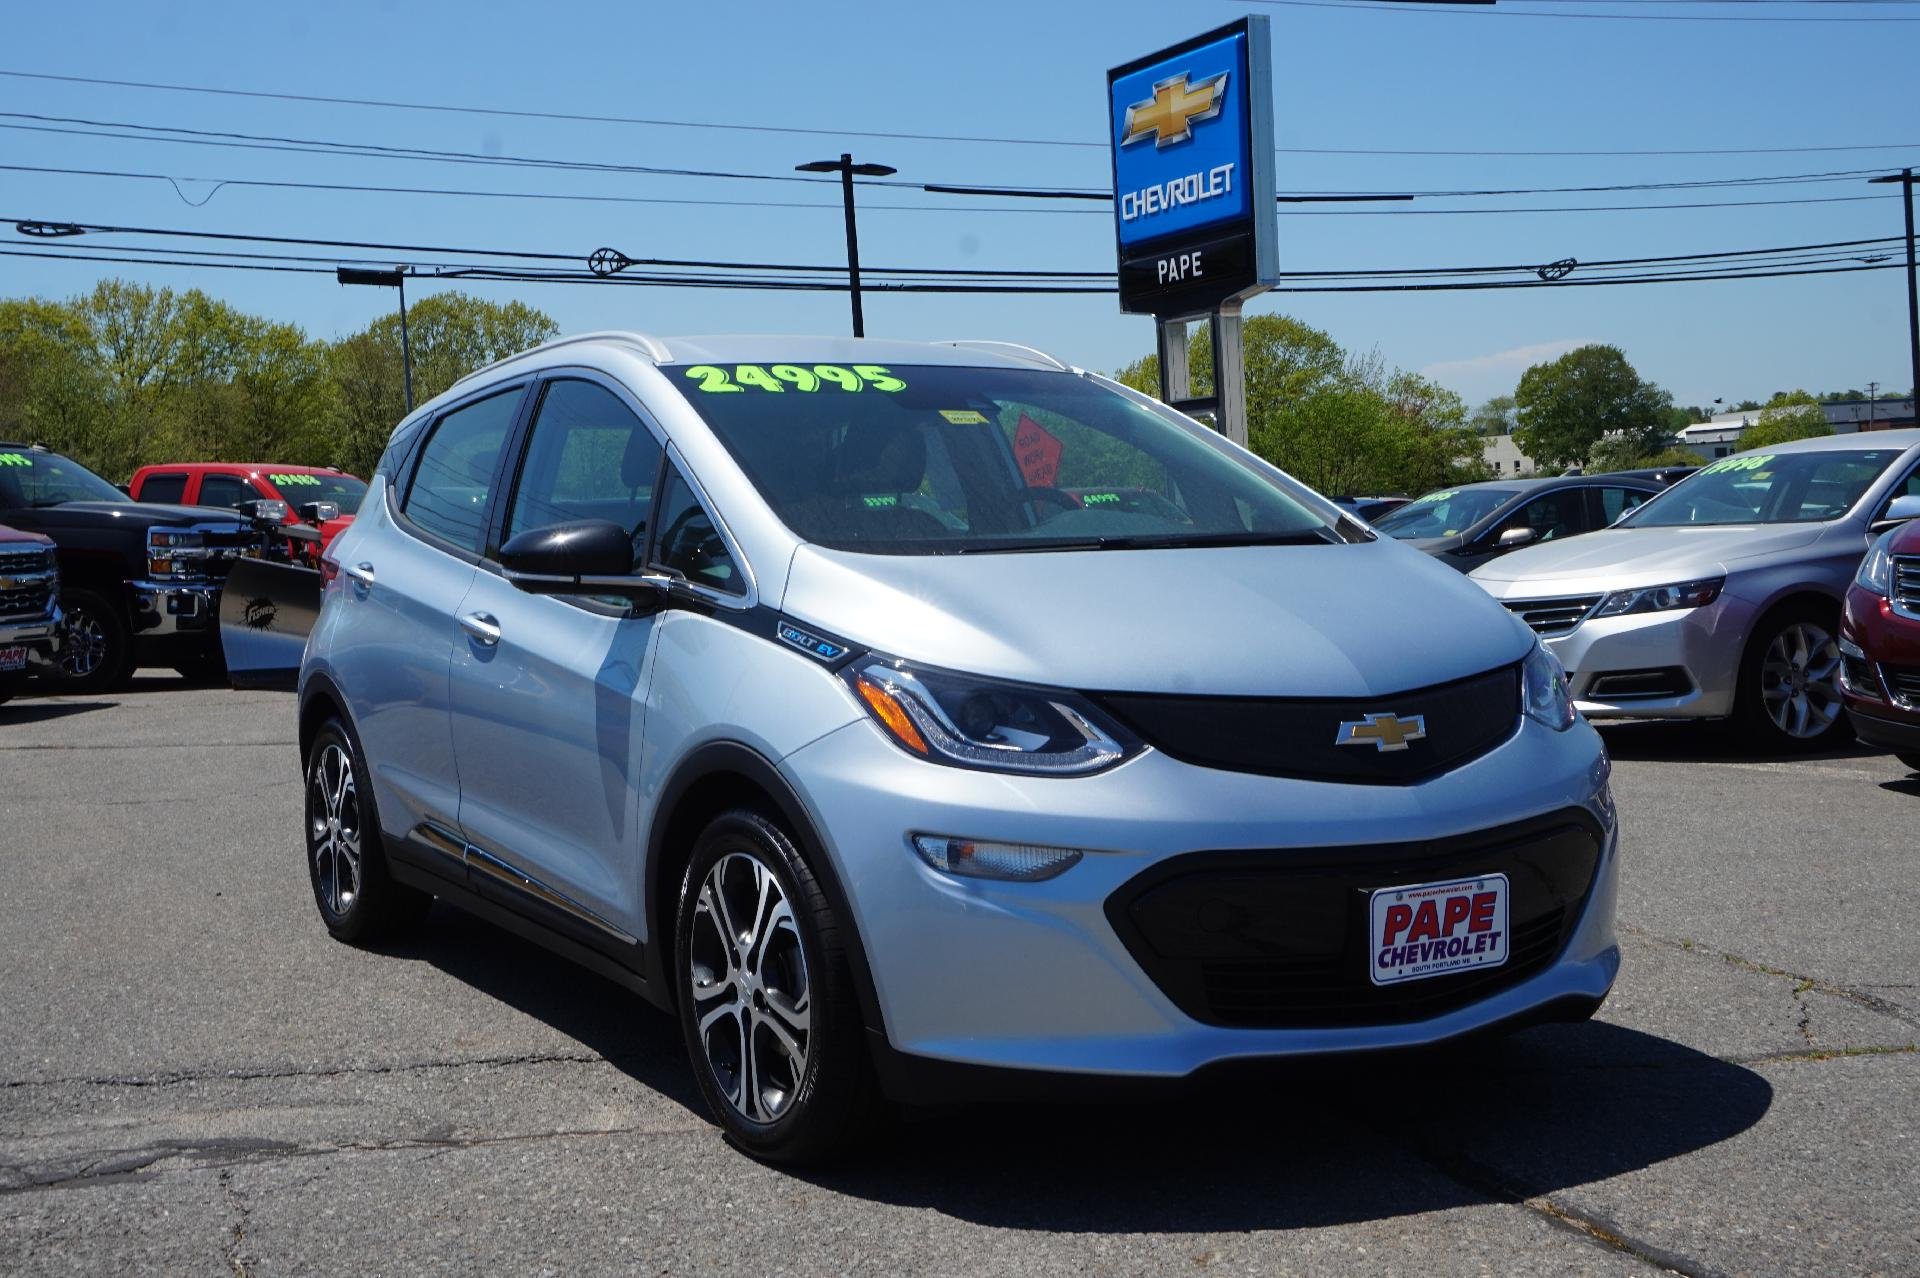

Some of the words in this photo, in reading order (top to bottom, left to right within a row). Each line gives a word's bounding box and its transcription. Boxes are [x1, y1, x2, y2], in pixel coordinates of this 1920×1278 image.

[1122, 162, 1235, 221] CHEVROLET
[1157, 251, 1203, 284] PAPE
[685, 364, 907, 393] 24995
[782, 627, 818, 648] BOLT
[816, 643, 839, 656] EV
[1382, 891, 1498, 947] PAPE
[1377, 931, 1502, 969] CHEVROLET
[1411, 964, 1431, 973] SOUTH
[1432, 960, 1461, 970] PORTLAND
